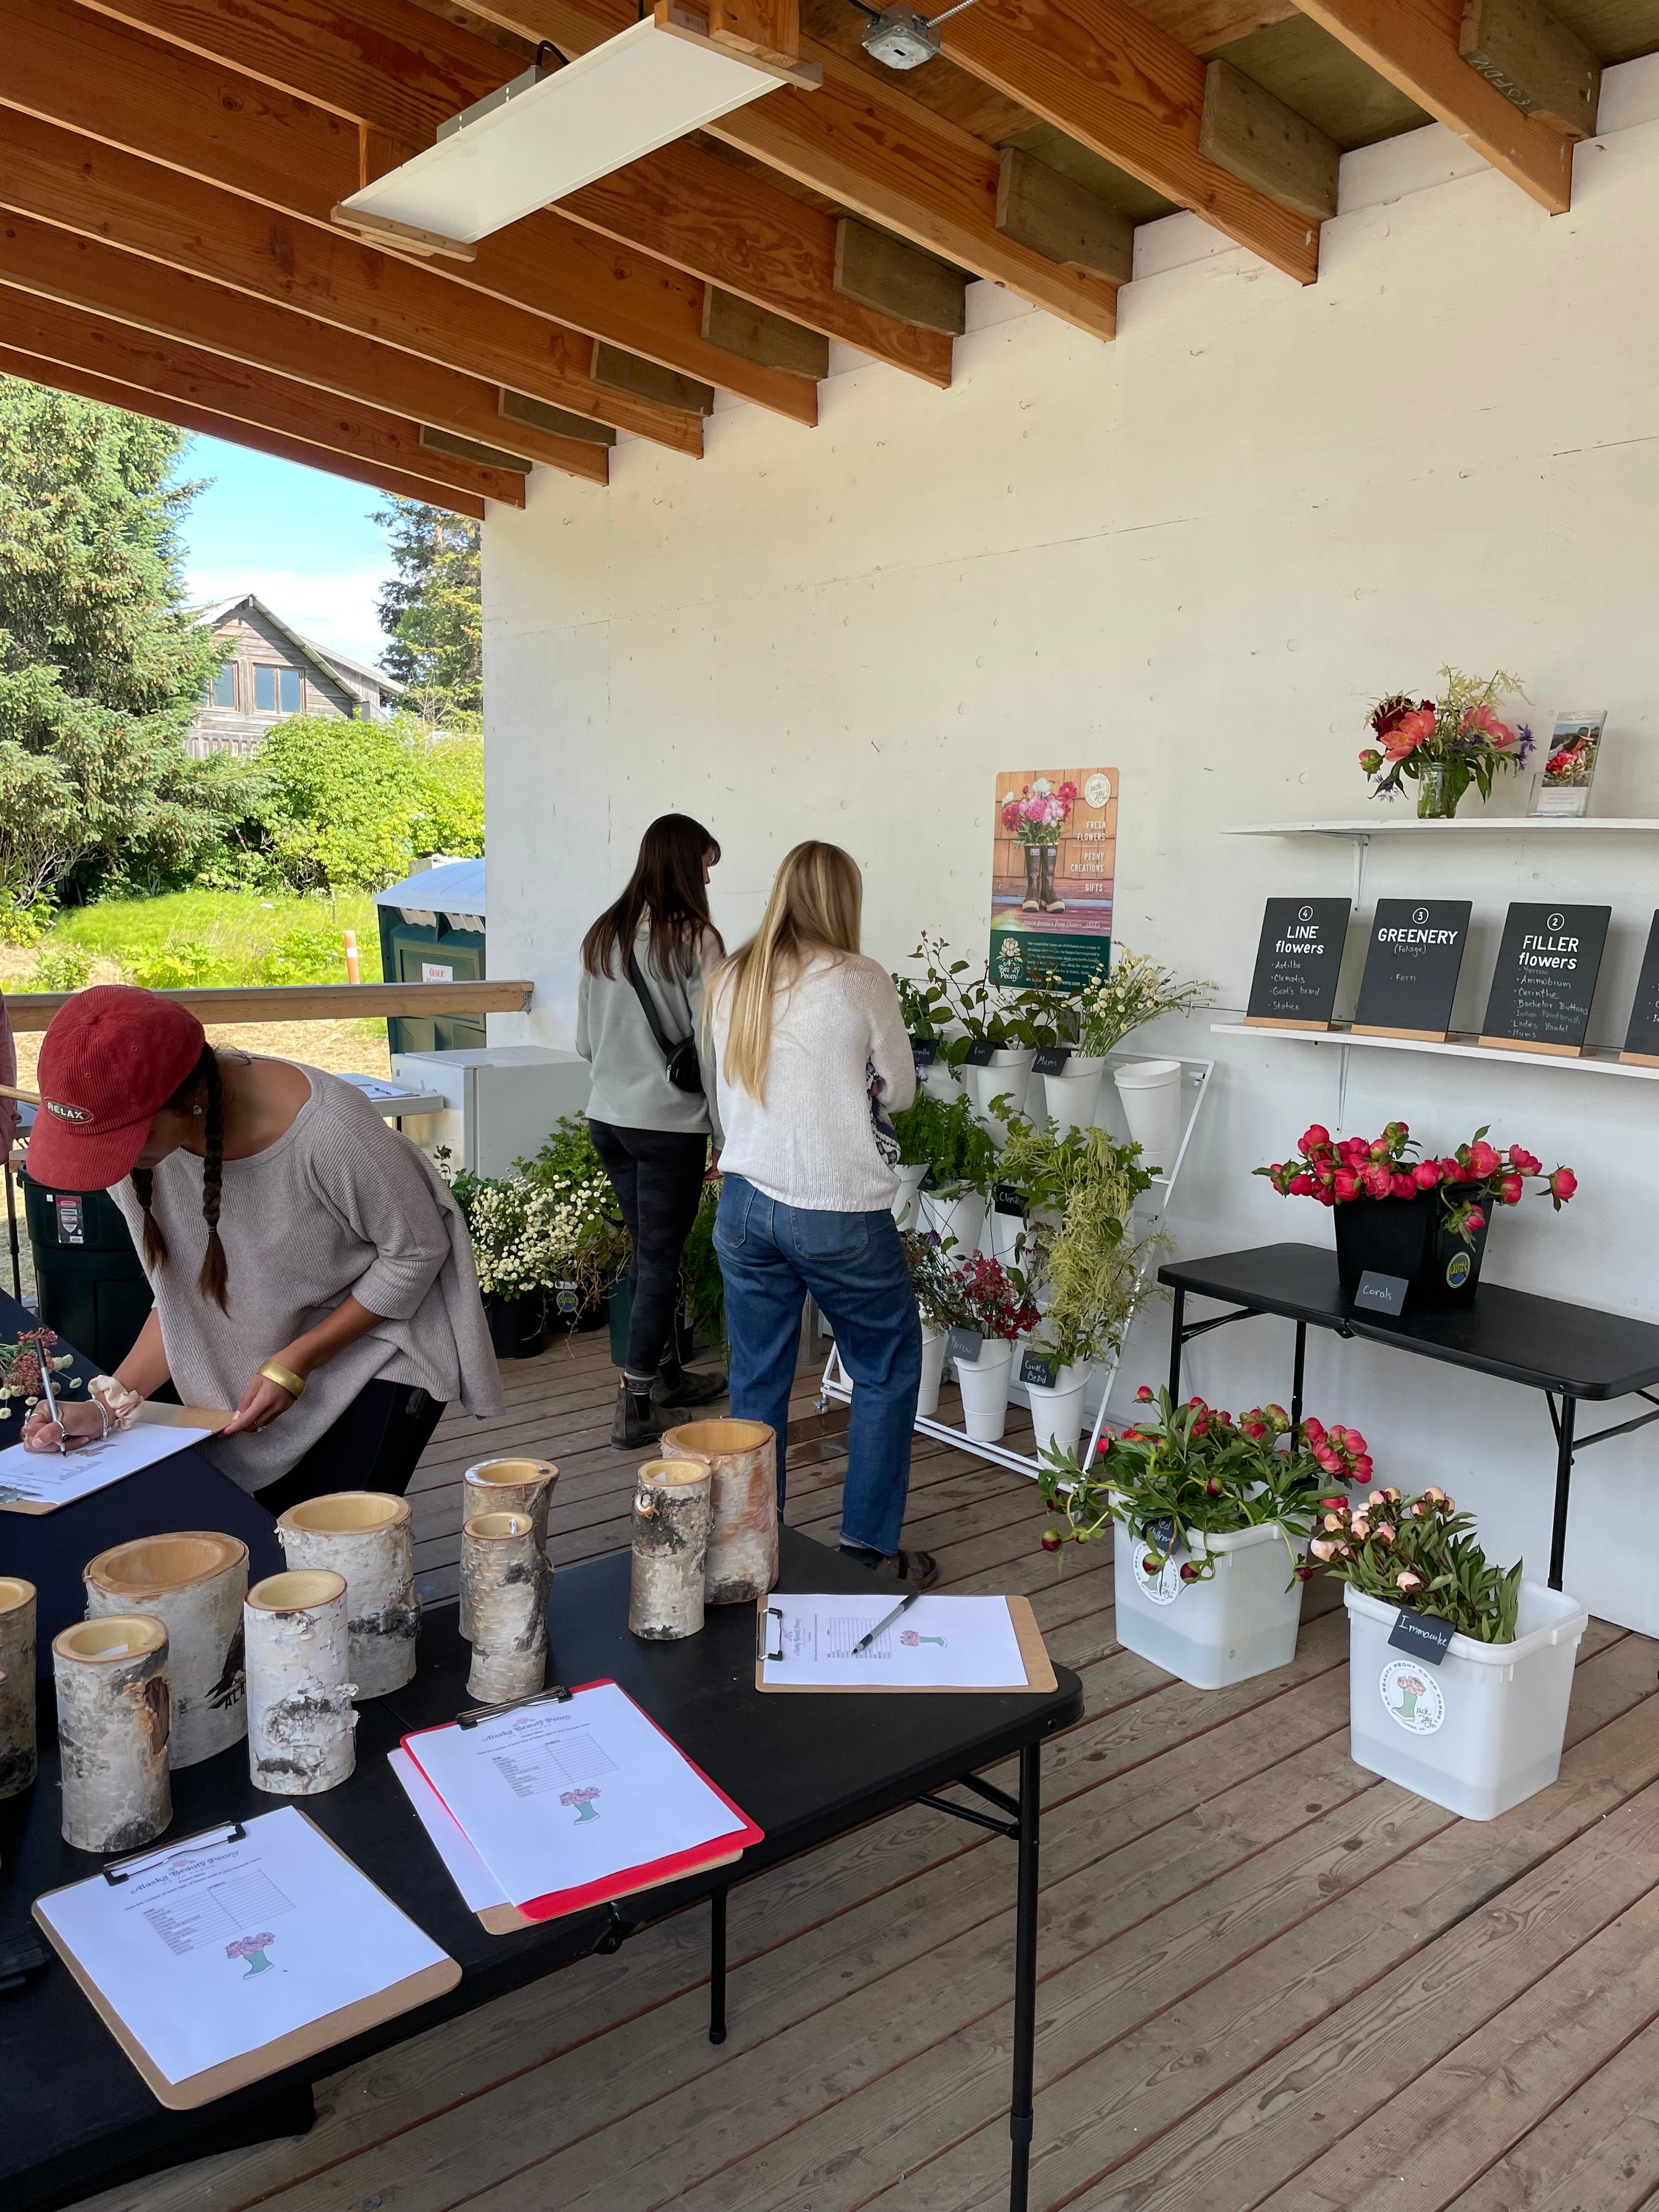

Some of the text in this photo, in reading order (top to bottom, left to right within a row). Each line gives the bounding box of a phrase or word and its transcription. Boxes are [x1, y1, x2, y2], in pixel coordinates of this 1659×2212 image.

[1086, 821, 1106, 830] FRESH
[1077, 833, 1105, 841] FLOWERS
[1084, 853, 1104, 861] PEONY
[1070, 864, 1104, 872] CREATIONS
[1085, 883, 1103, 892] GIFTS
[1286, 926, 1319, 939] LINE
[1378, 928, 1458, 945] GREENERY
[1276, 940, 1324, 955] flowers
[1522, 935, 1579, 952] FILLER
[1394, 944, 1426, 957] (Foliage)
[1275, 960, 1301, 969] Astilbe
[1519, 952, 1577, 970] flowers
[430, 968, 445, 978] QUICK
[1001, 972, 1018, 982] Peony
[1274, 974, 1305, 984] Clematis
[1396, 974, 1416, 982] Fern
[1520, 975, 1571, 989] Ammobium
[1300, 986, 1320, 996] beard
[1518, 988, 1560, 1000] Cerinthe
[1273, 1001, 1300, 1011] Statice
[1518, 1000, 1589, 1015] Bachelor Buttons
[1036, 1056, 1057, 1067] Mums
[47, 1102, 84, 1120] RELAX
[1363, 1285, 1392, 1300] Corals
[951, 1335, 972, 1354] Yarrow
[1027, 1371, 1047, 1384] Beard
[1383, 1667, 1392, 1692] BEAUTY
[1419, 1669, 1437, 1691] CO-OP
[1385, 1697, 1391, 1706] AK
[1417, 1707, 1431, 1716] pick
[482, 1729, 512, 1742] Alaska
[513, 1720, 544, 1731] Beauty
[545, 1714, 571, 1723] Peony
[131, 1850, 239, 1894] Alaska Beauty Peony
